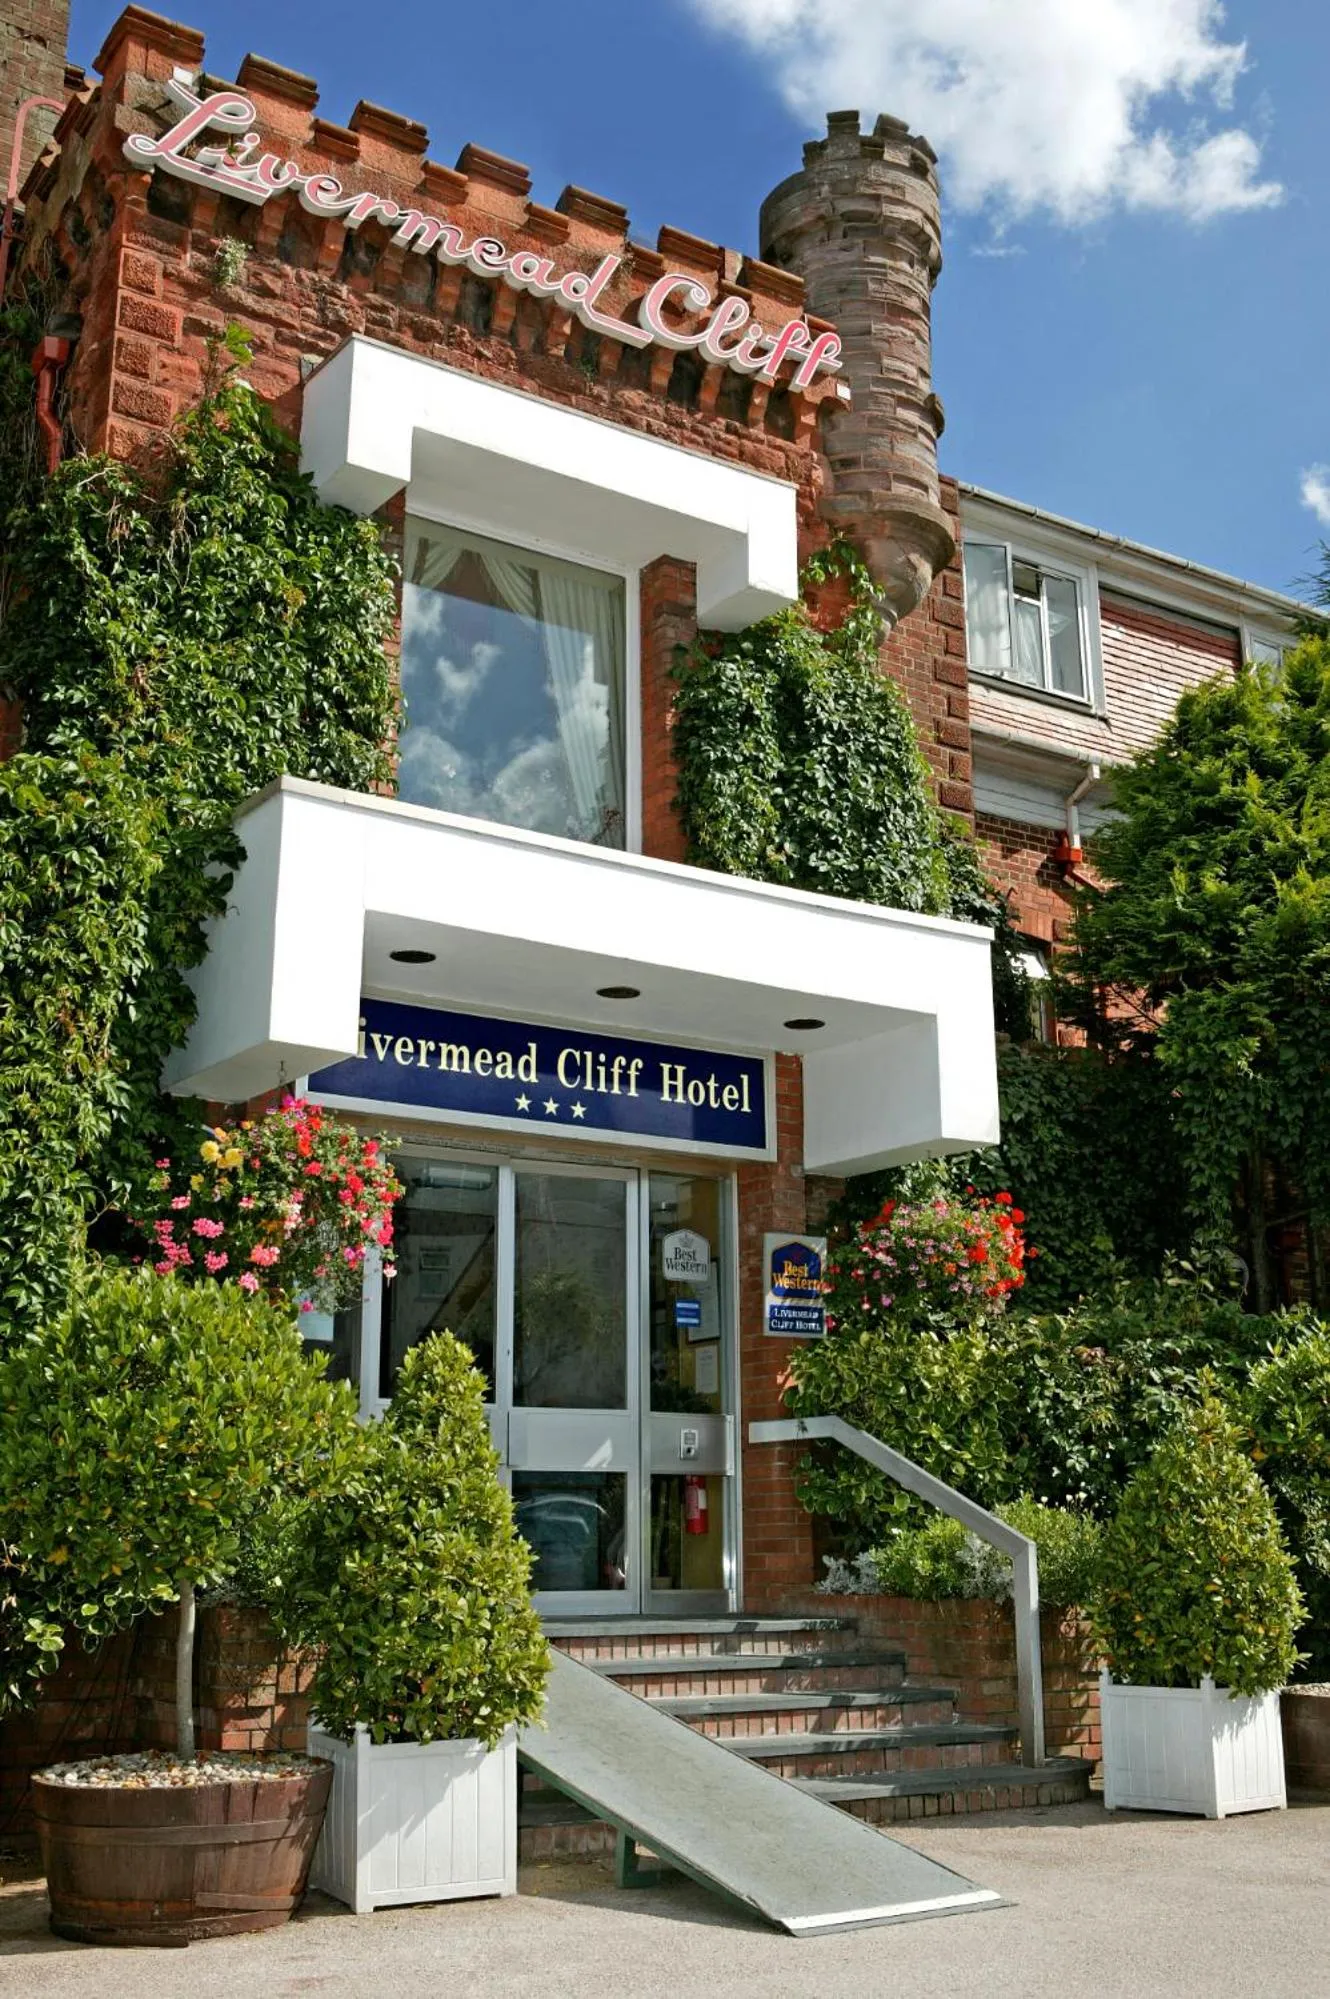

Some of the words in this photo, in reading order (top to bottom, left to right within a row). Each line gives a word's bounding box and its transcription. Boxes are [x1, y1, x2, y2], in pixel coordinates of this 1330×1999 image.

[123, 78, 655, 349] Livermead
[638, 273, 843, 393] Cliff
[357, 1017, 539, 1084] ivermead
[557, 1048, 644, 1097] Cliff
[659, 1062, 753, 1113] Hotel
[674, 1247, 697, 1262] Best
[665, 1257, 707, 1274] Western
[784, 1261, 808, 1276] Best
[796, 1321, 821, 1331] HOTEL
